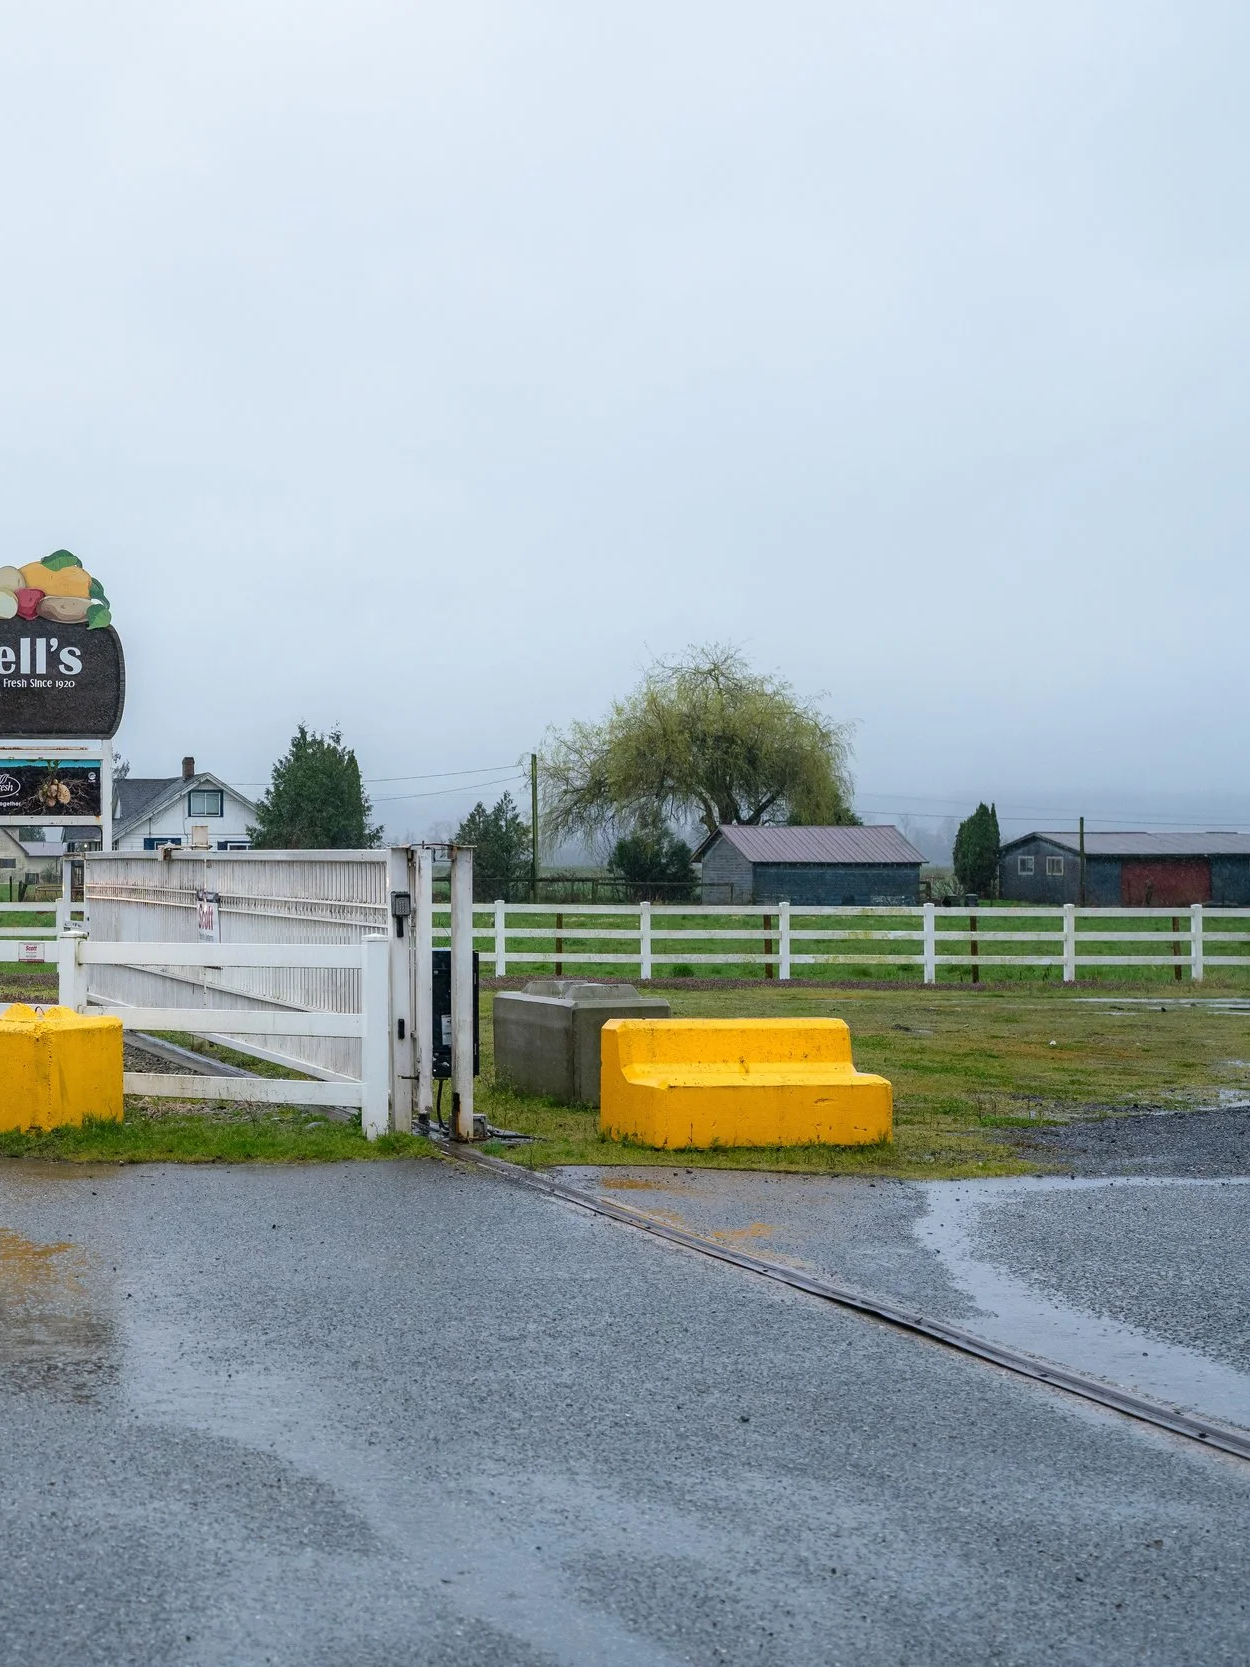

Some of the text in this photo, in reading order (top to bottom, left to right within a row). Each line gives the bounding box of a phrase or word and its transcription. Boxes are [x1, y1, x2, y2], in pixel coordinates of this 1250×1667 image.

[3, 677, 28, 688] Fresh
[30, 677, 53, 689] Since
[55, 680, 76, 690] 1920
